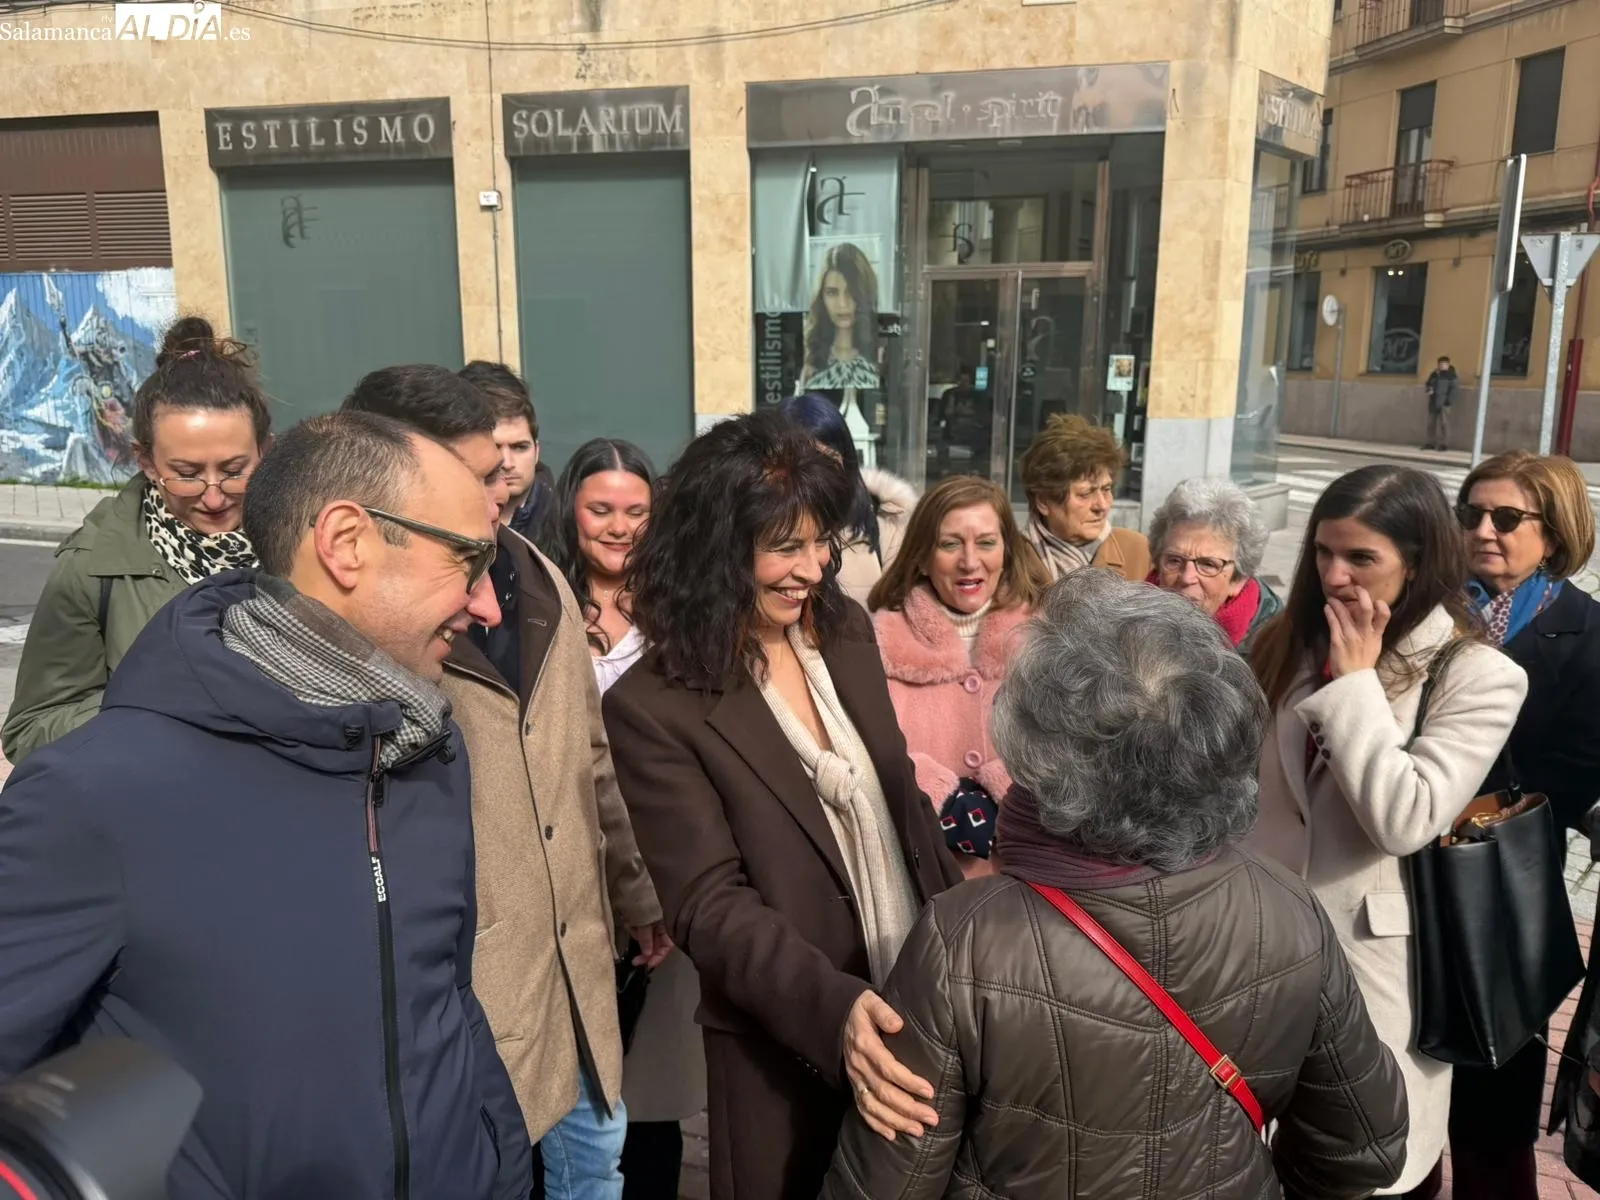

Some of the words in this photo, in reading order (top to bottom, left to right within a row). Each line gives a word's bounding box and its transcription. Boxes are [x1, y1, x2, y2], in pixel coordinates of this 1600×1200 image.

[216, 113, 435, 150] ESTILISMO
[512, 103, 685, 139] SOLARIUM
[371, 856, 387, 903] ECOALF
